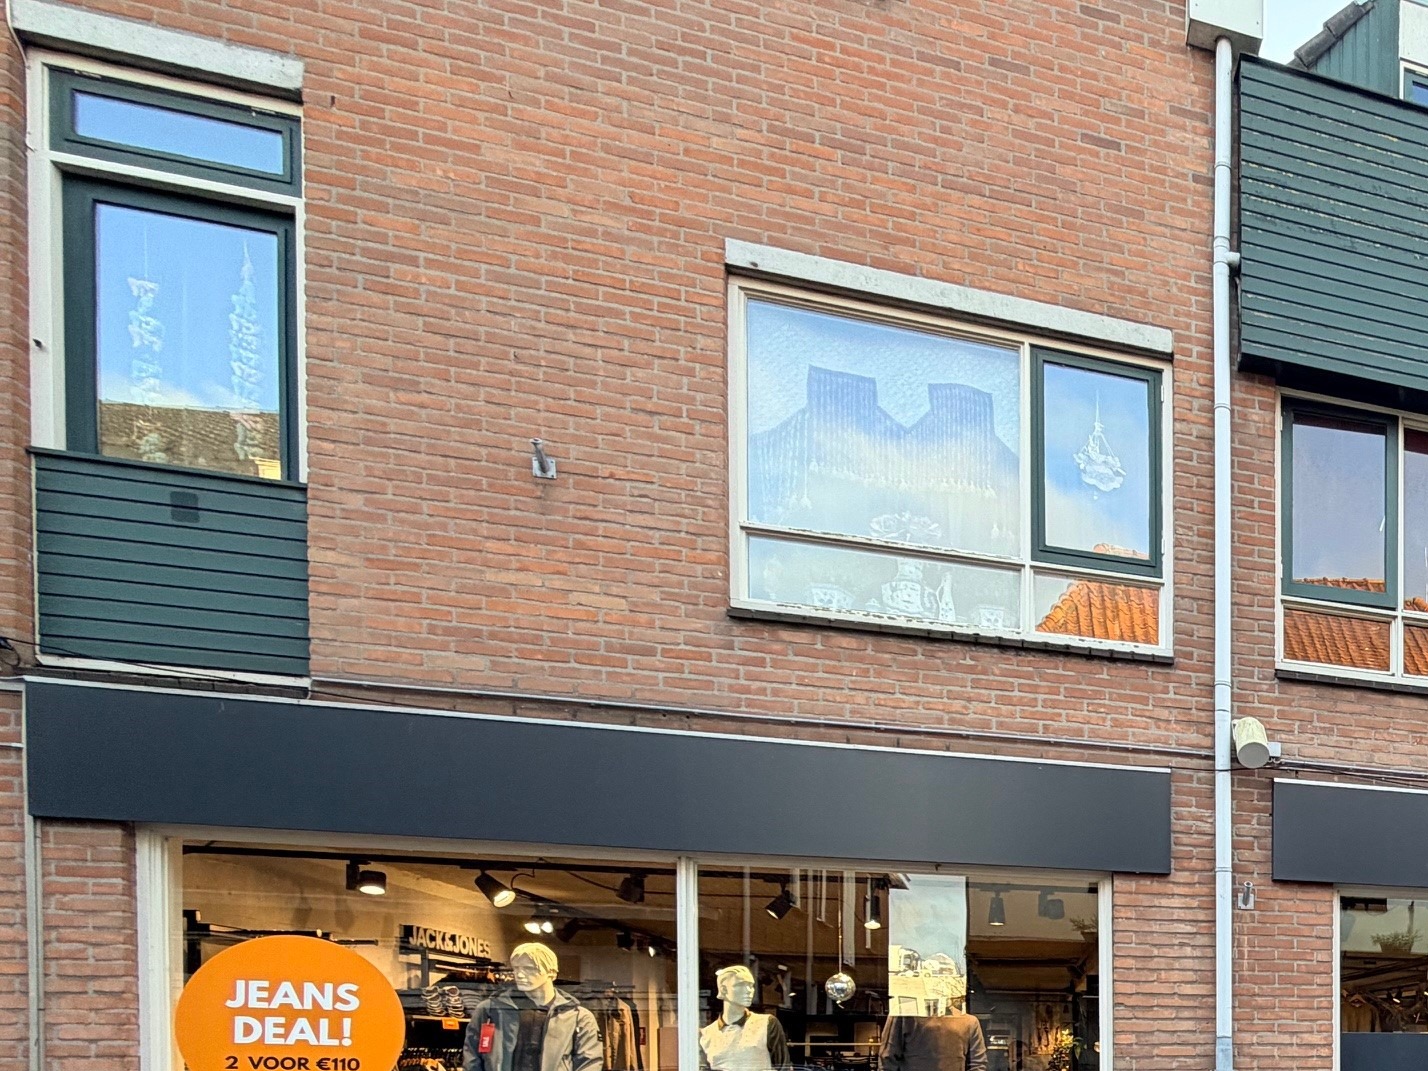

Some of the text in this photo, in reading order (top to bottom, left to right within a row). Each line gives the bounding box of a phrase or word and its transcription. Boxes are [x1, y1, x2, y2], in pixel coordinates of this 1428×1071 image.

[408, 925, 491, 957] JACK&JONES
[224, 979, 360, 1011] JEANS
[233, 1015, 353, 1046] DEAL!
[225, 1055, 360, 1071] 2 VOOR €110
